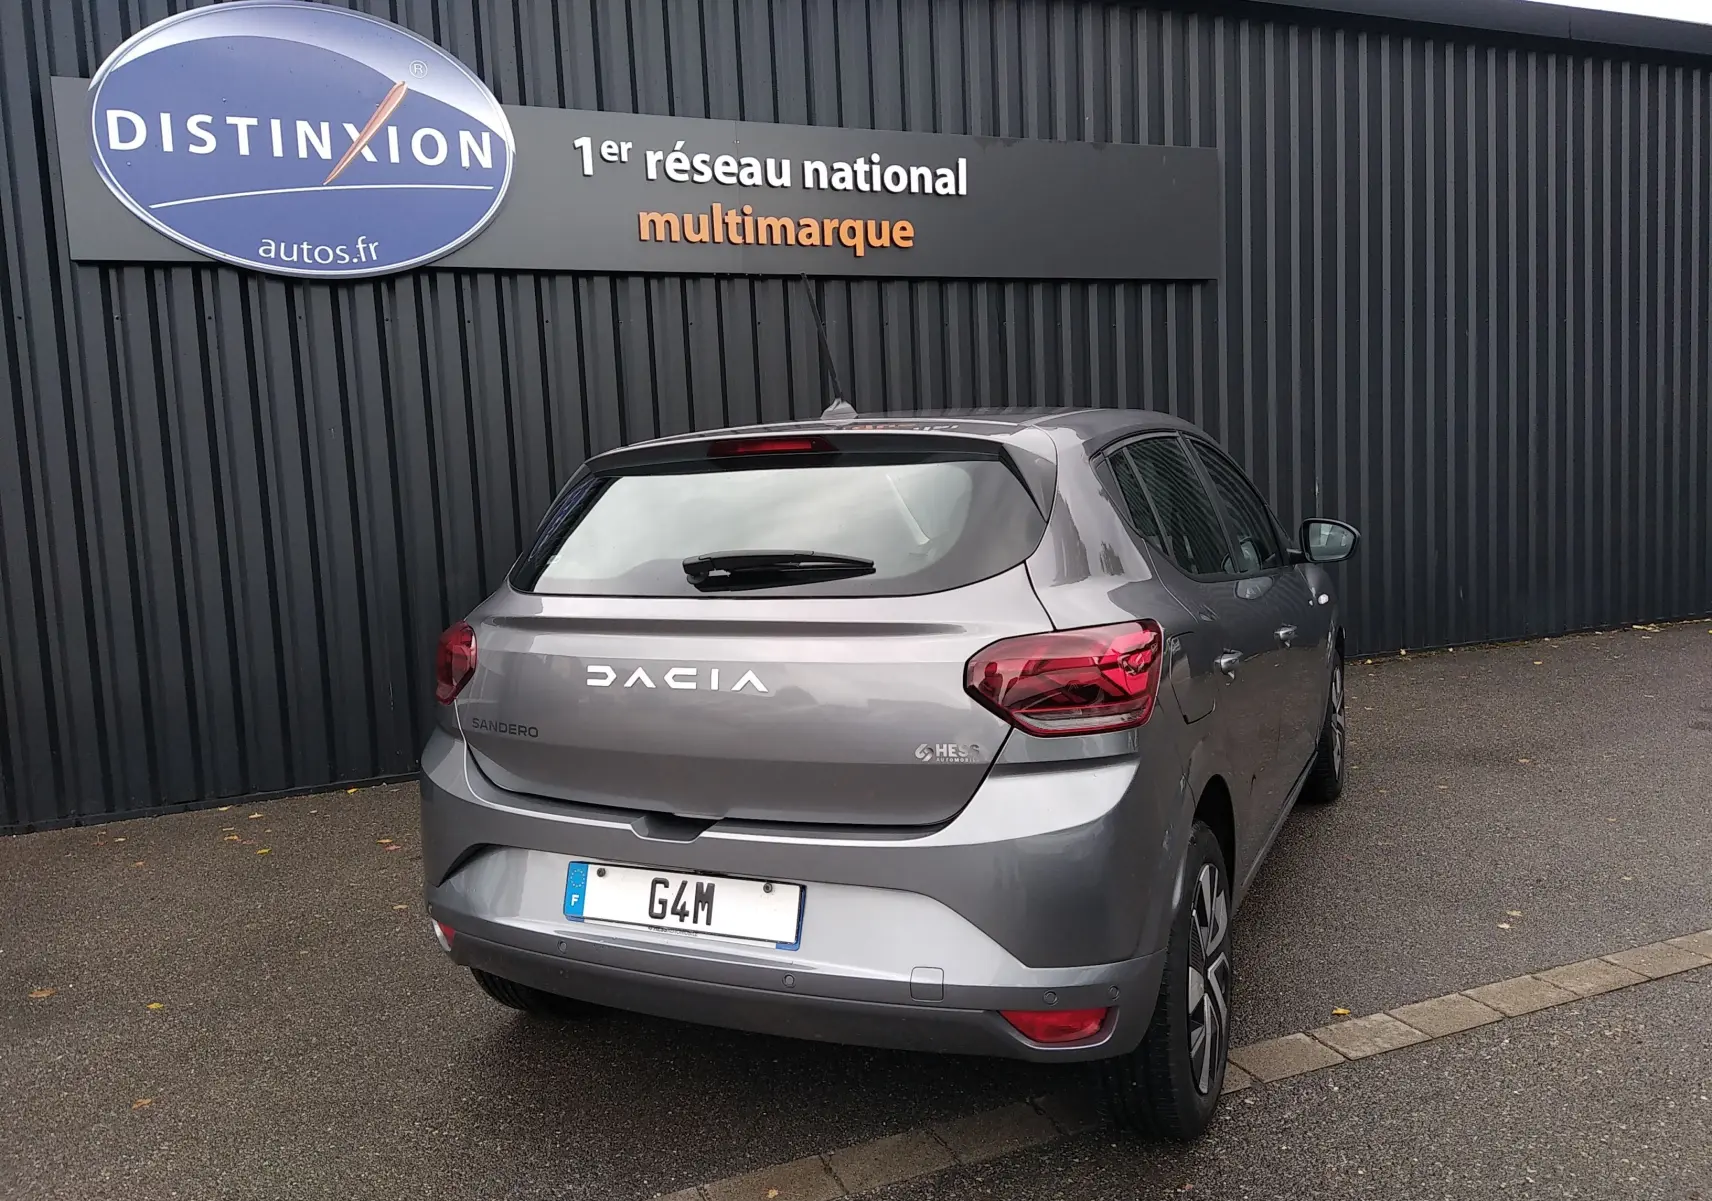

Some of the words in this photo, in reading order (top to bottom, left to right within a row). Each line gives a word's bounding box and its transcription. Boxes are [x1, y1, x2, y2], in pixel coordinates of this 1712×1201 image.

[106, 82, 493, 184] DISTINXION
[573, 136, 632, 176] 1er
[646, 141, 791, 187] réseau
[803, 153, 968, 196] national
[638, 203, 915, 257] multimarque
[258, 235, 379, 265] autos.fr
[586, 664, 769, 693] DACIA
[471, 717, 539, 738] SANDERO
[571, 894, 579, 906] F
[648, 877, 716, 926] G4M
